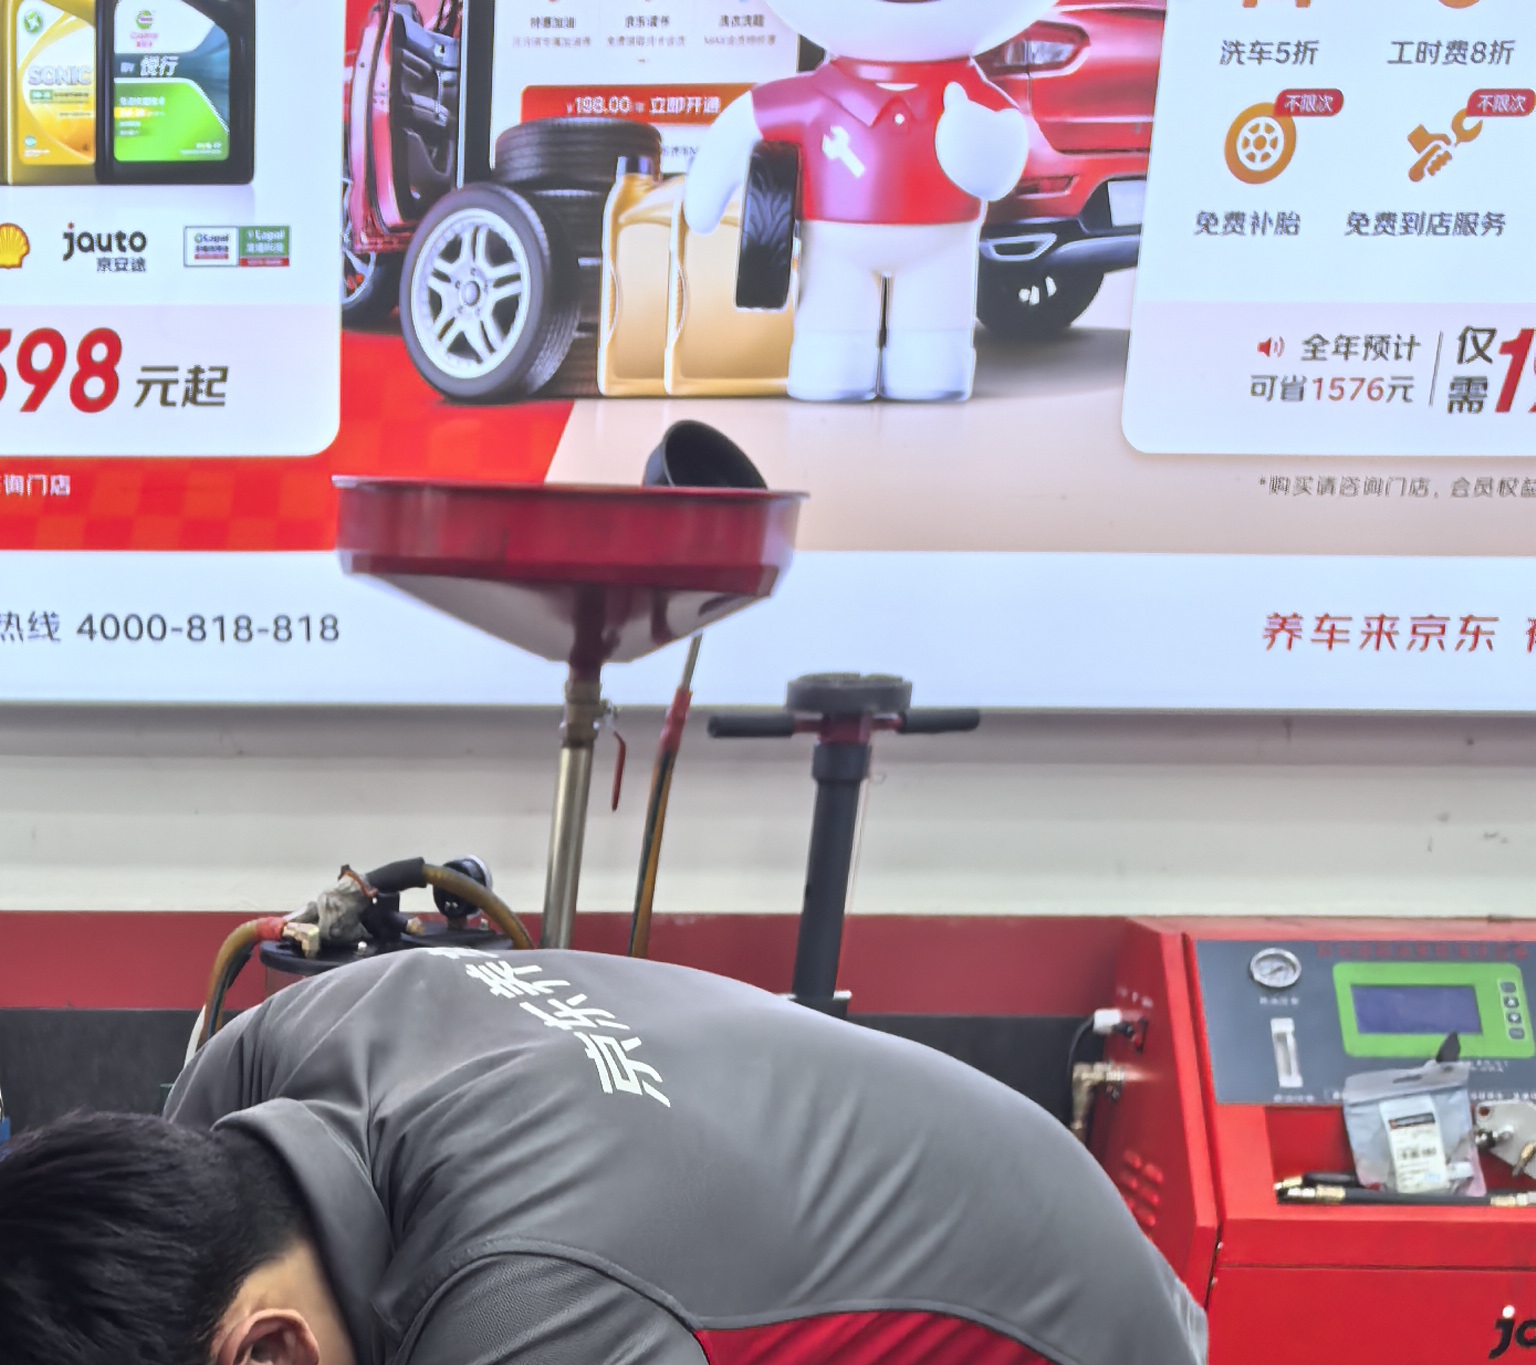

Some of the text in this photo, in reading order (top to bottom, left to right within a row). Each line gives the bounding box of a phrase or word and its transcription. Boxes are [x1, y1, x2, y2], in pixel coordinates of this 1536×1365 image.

[1219, 39, 1320, 65] 洗车5折
[1387, 39, 1516, 65] 工时费8折
[63, 222, 147, 261] jauto
[1300, 333, 1421, 362] 全年预计
[134, 364, 230, 409] 元起
[75, 612, 340, 643] 4000-818-818
[1263, 613, 1500, 652] 养车来京东
